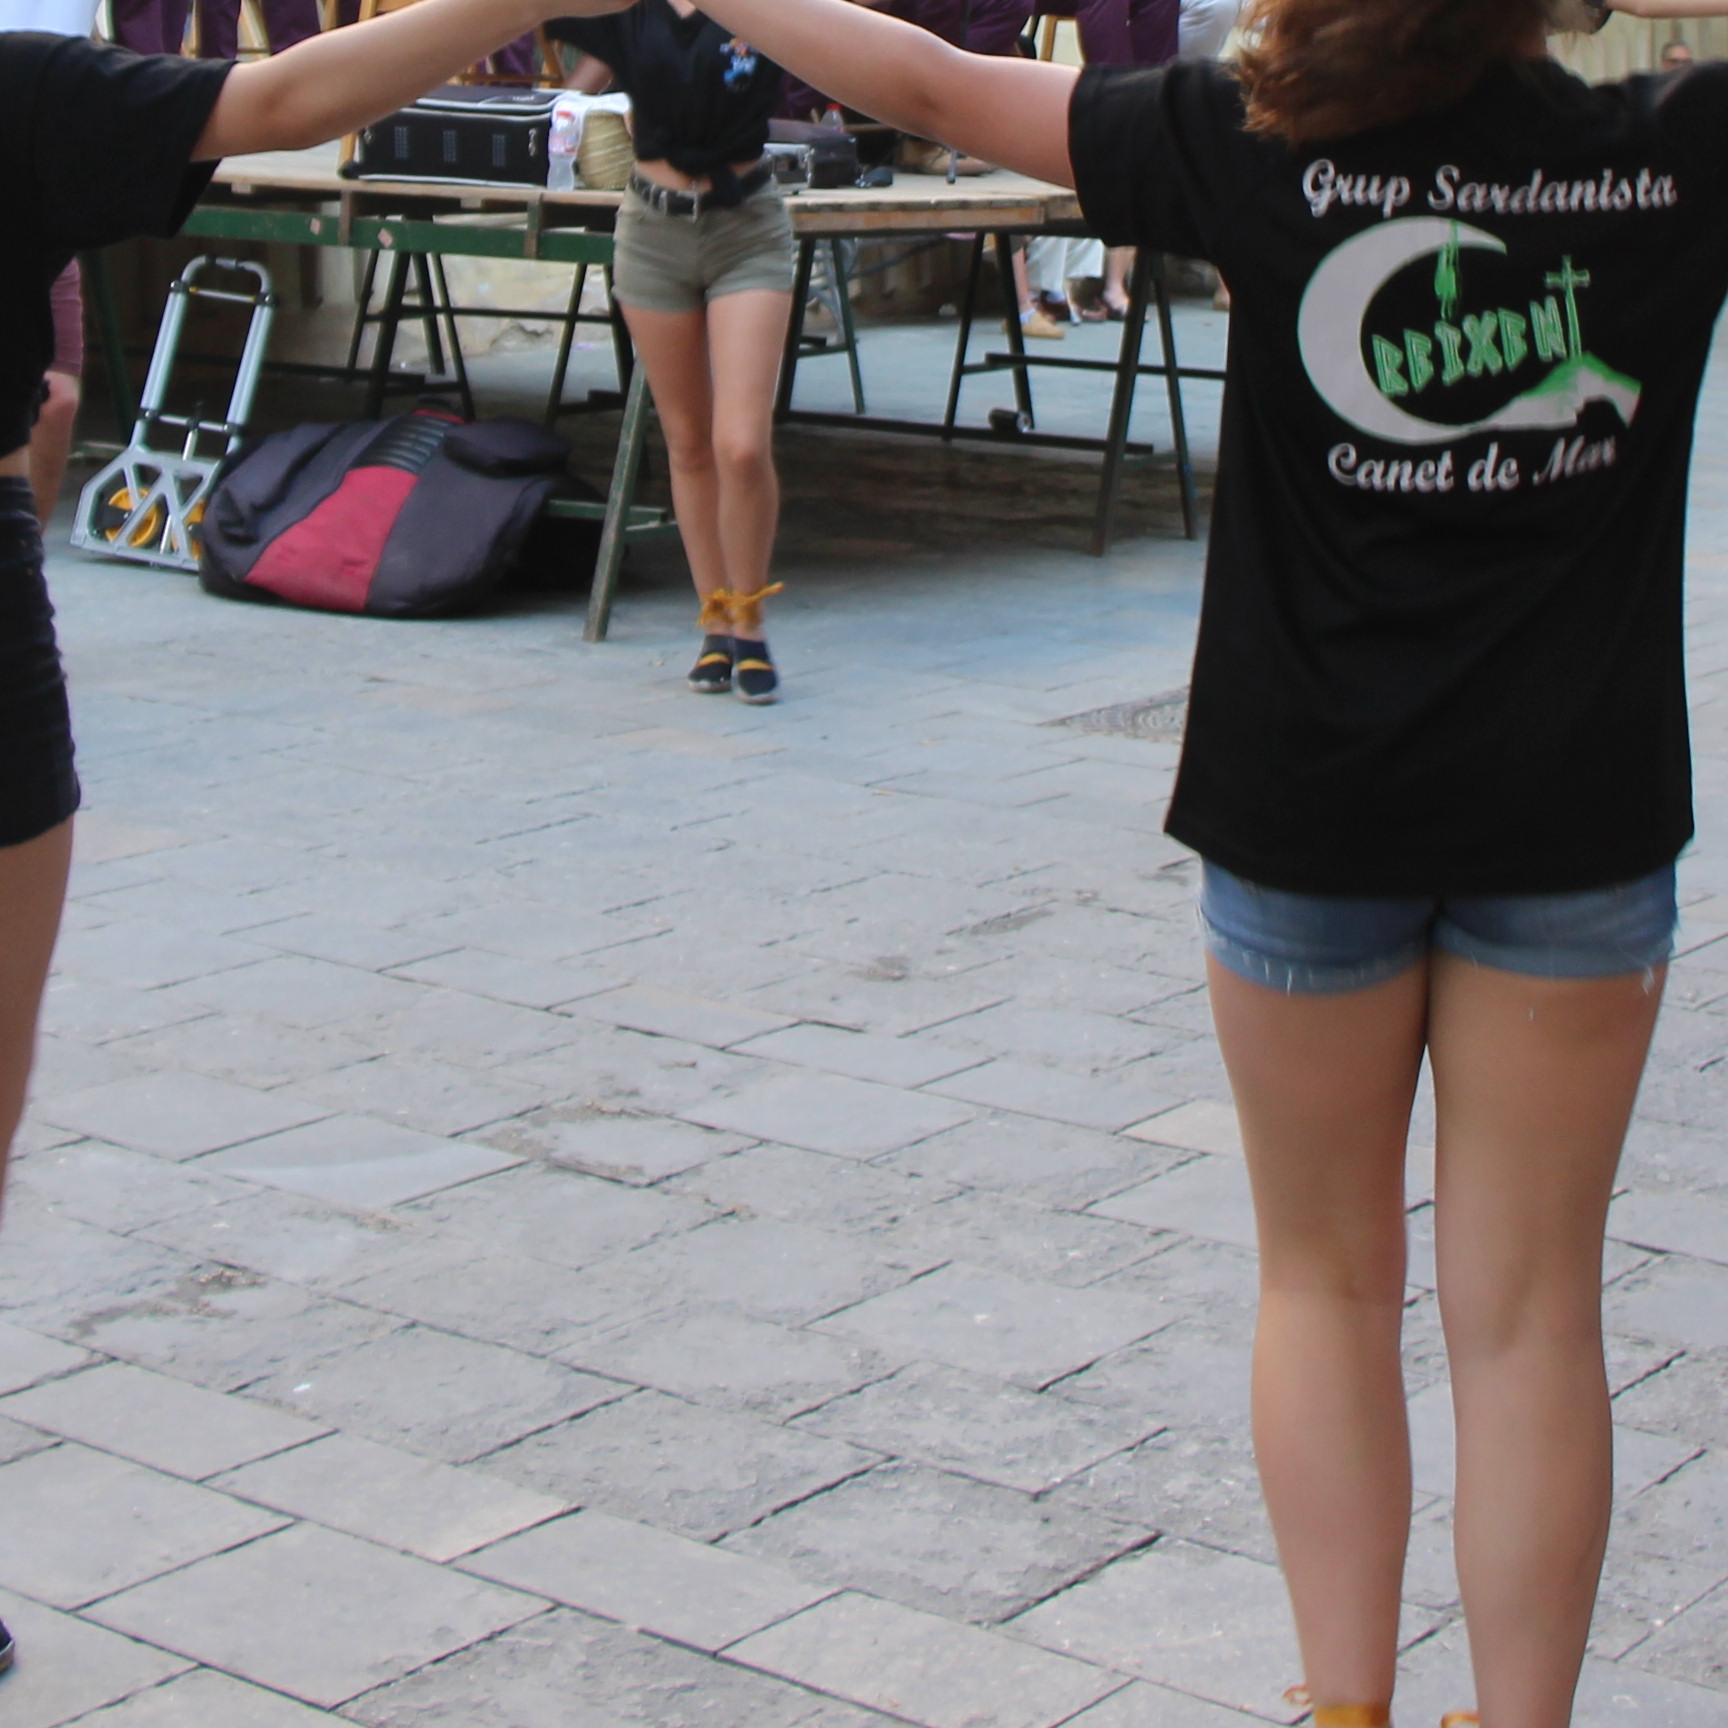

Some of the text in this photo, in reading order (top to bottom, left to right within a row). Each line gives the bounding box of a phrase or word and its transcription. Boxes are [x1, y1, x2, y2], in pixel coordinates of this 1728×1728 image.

[1303, 159, 1678, 217] Grup Sardanista
[1328, 435, 1617, 492] Canet de Mar
